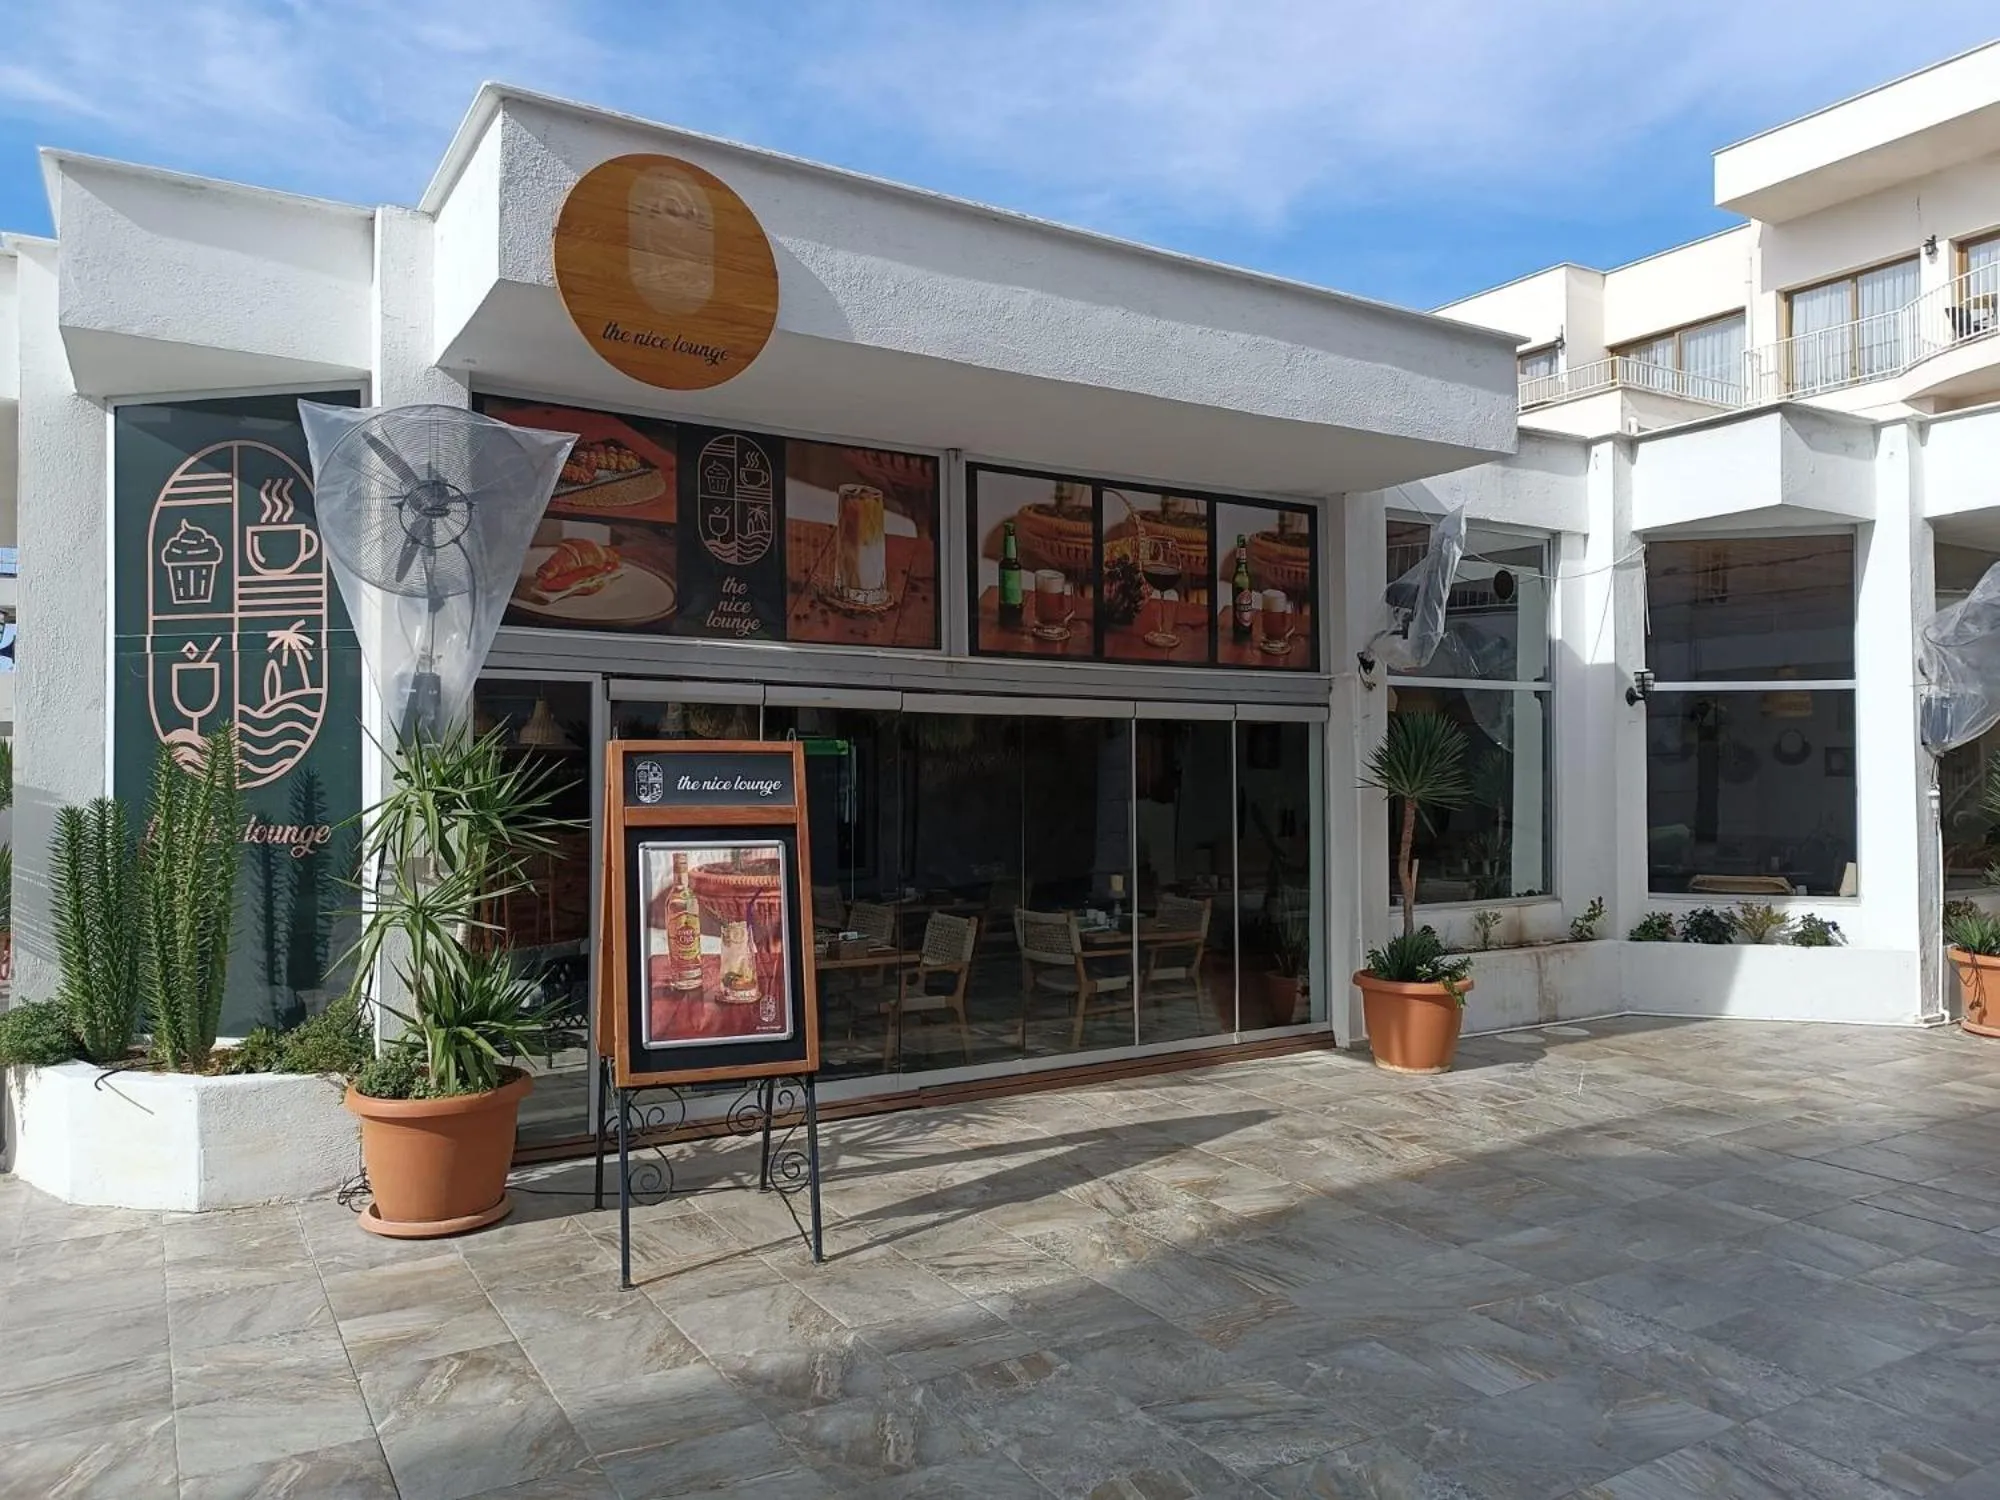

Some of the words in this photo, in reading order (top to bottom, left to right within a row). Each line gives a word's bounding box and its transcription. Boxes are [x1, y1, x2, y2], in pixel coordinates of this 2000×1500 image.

[602, 320, 631, 343] the
[633, 330, 669, 350] nice
[672, 334, 730, 366] lounge
[722, 576, 748, 595] the
[718, 595, 752, 613] nice
[705, 610, 761, 637] lounge
[677, 775, 701, 791] the
[702, 776, 732, 791] nice
[733, 775, 782, 797] lounge
[242, 813, 332, 858] lounge
